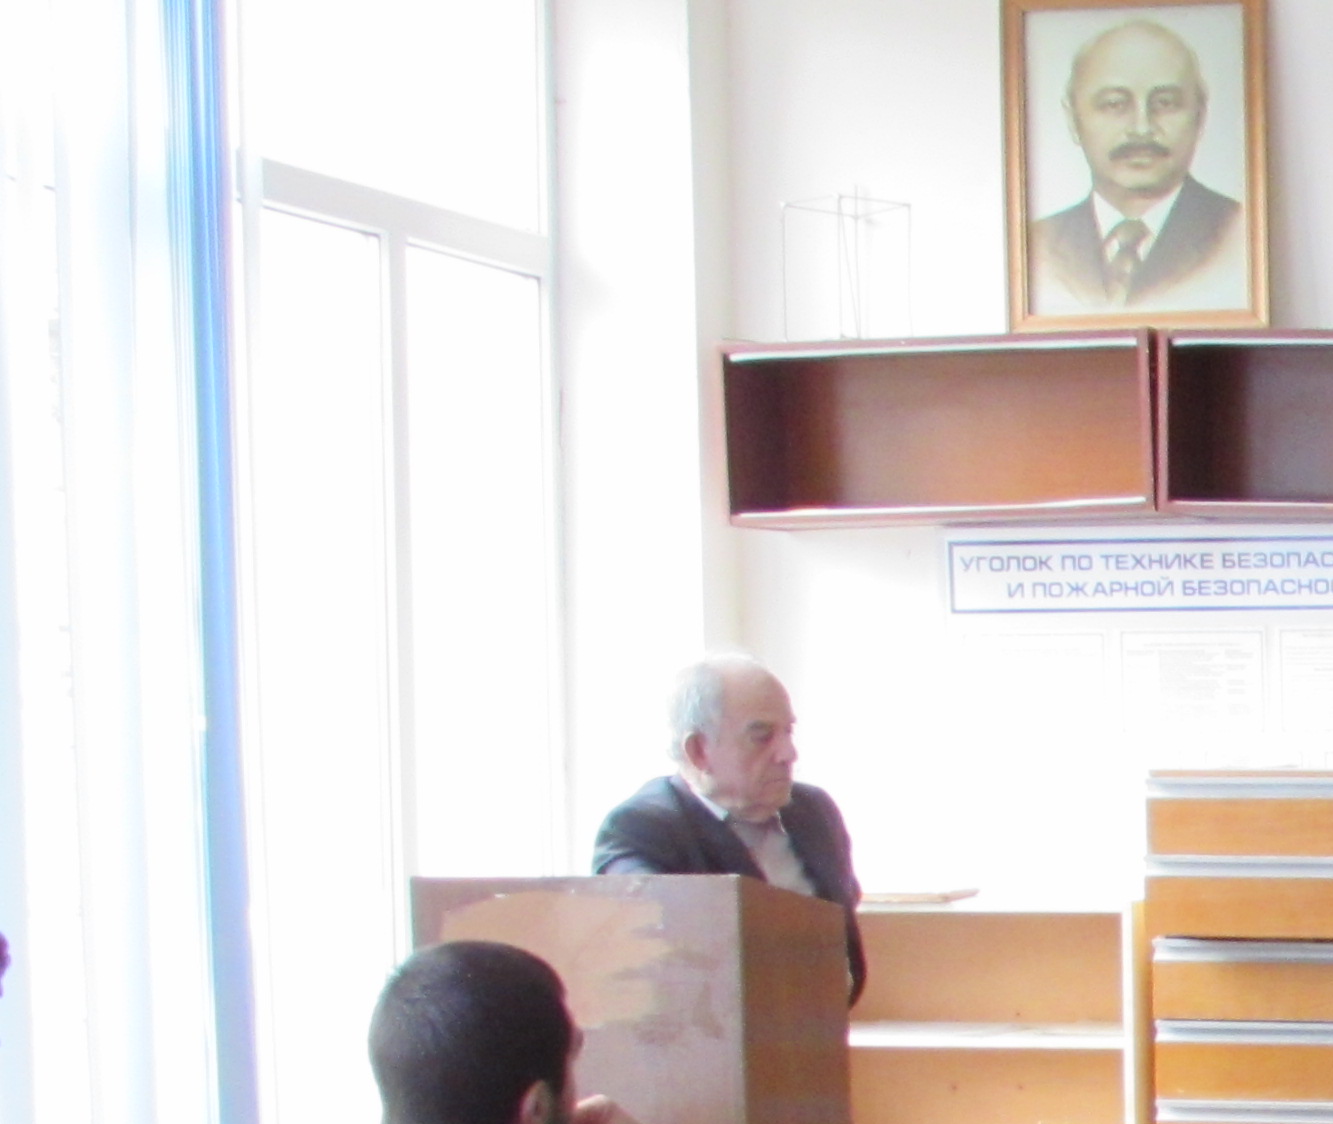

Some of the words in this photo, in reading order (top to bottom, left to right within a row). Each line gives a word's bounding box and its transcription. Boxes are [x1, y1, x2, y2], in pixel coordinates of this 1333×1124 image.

[960, 554, 1053, 573] УГОЛОК
[1061, 554, 1093, 572] ПО
[1100, 552, 1214, 571] ТЕХНИКЕ
[1007, 581, 1025, 599] И
[1032, 576, 1175, 598] ПОЖАРНОЙ
